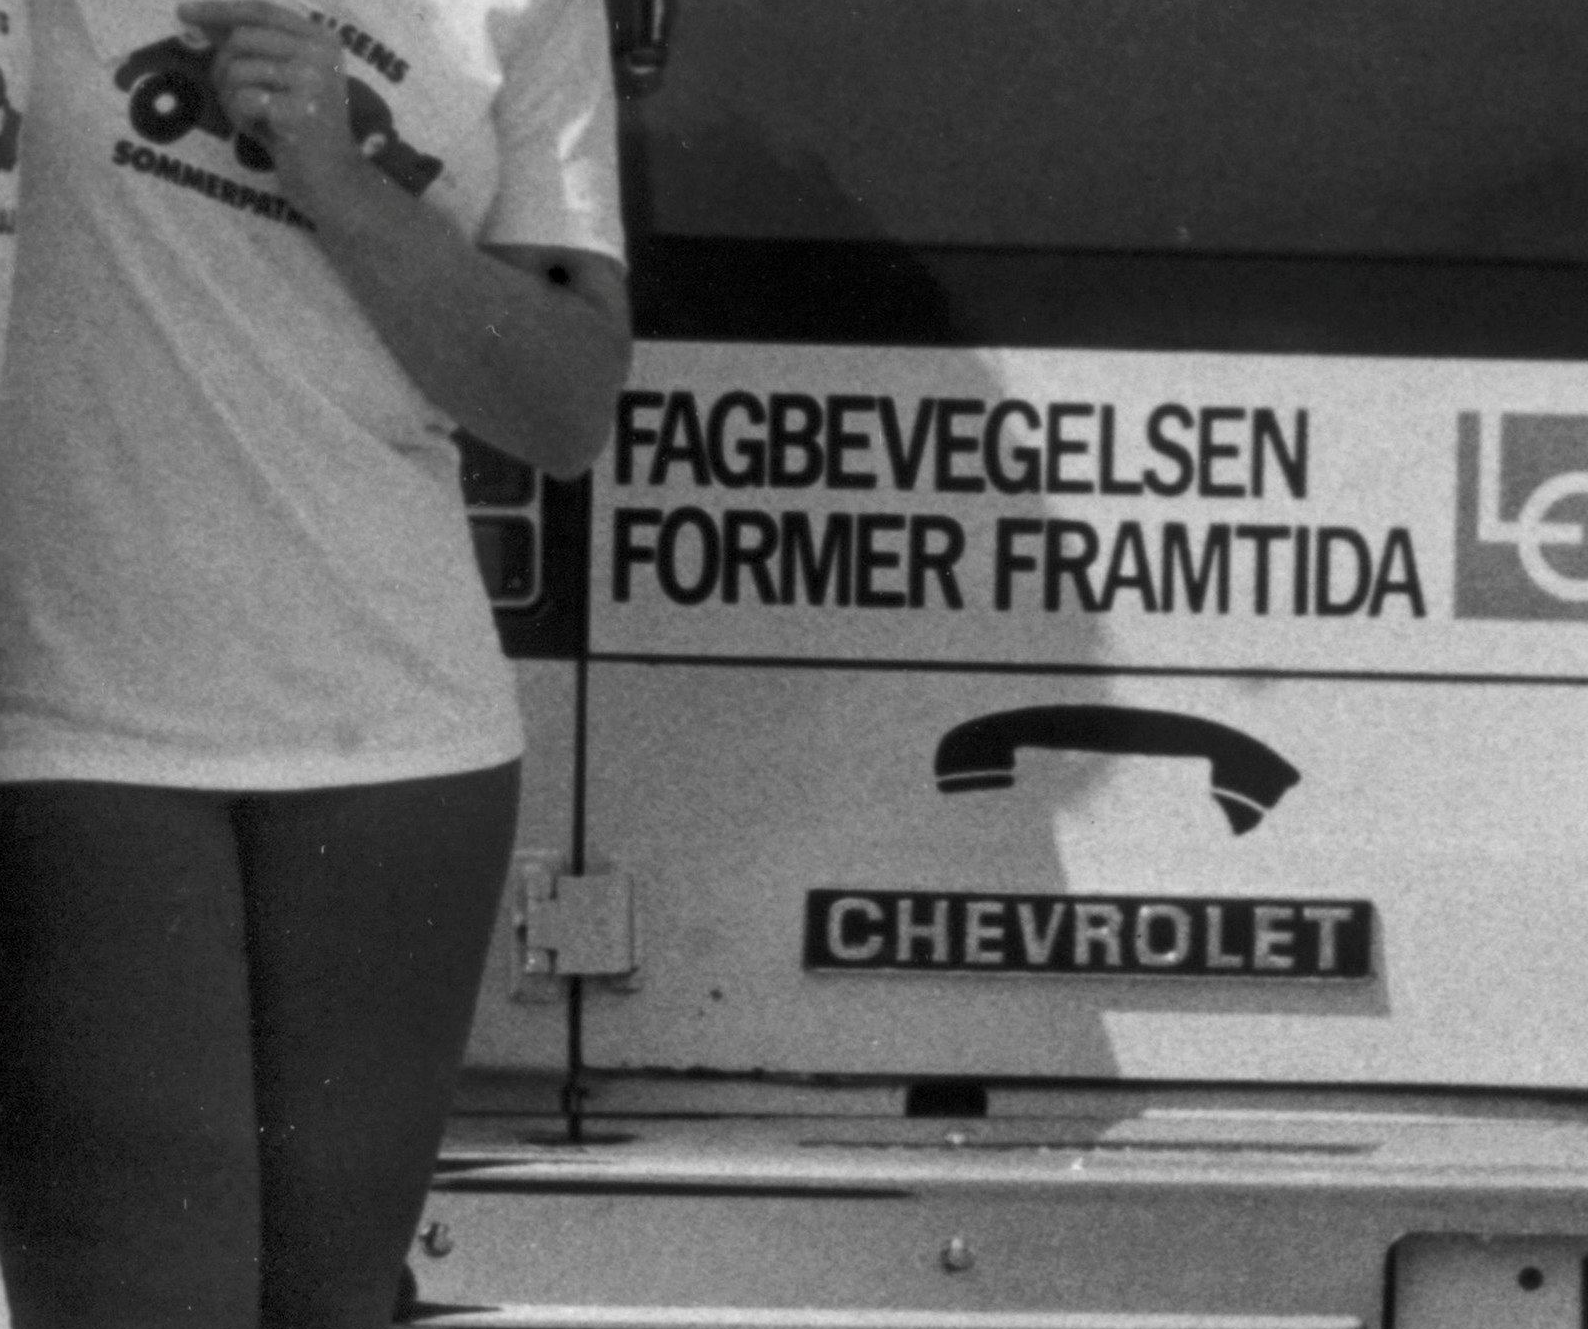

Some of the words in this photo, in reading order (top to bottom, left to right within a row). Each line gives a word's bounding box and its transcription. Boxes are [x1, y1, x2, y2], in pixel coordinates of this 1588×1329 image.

[613, 389, 1310, 501] FAGBEVEGELSEN
[612, 505, 965, 612] FORMER
[993, 516, 1427, 619] FRAMTIDA
[826, 896, 1355, 970] CHEVROLET
